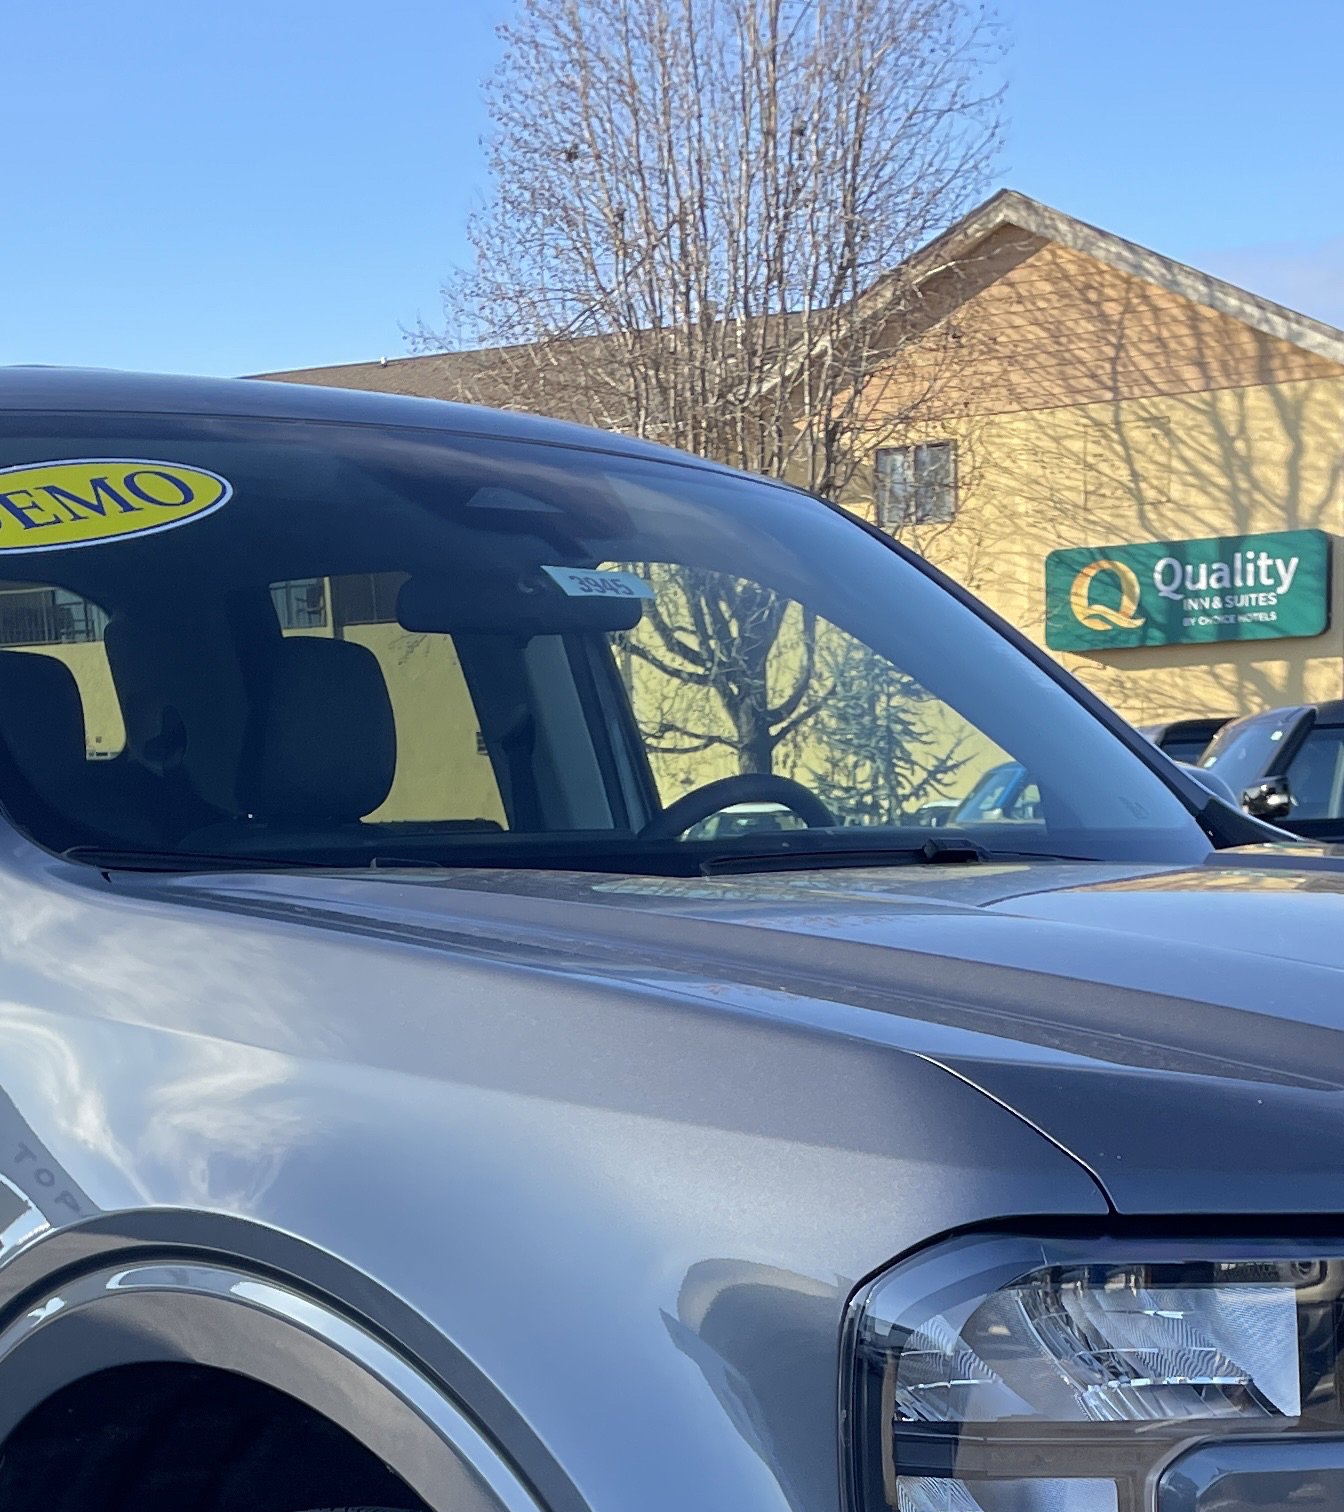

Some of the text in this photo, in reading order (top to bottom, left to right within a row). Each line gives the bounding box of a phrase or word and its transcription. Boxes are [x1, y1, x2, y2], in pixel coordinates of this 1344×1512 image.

[569, 575, 634, 595] 3945
[1154, 551, 1299, 600] Quality
[1071, 560, 1146, 631] Q
[1183, 591, 1278, 611] INN & SUITES
